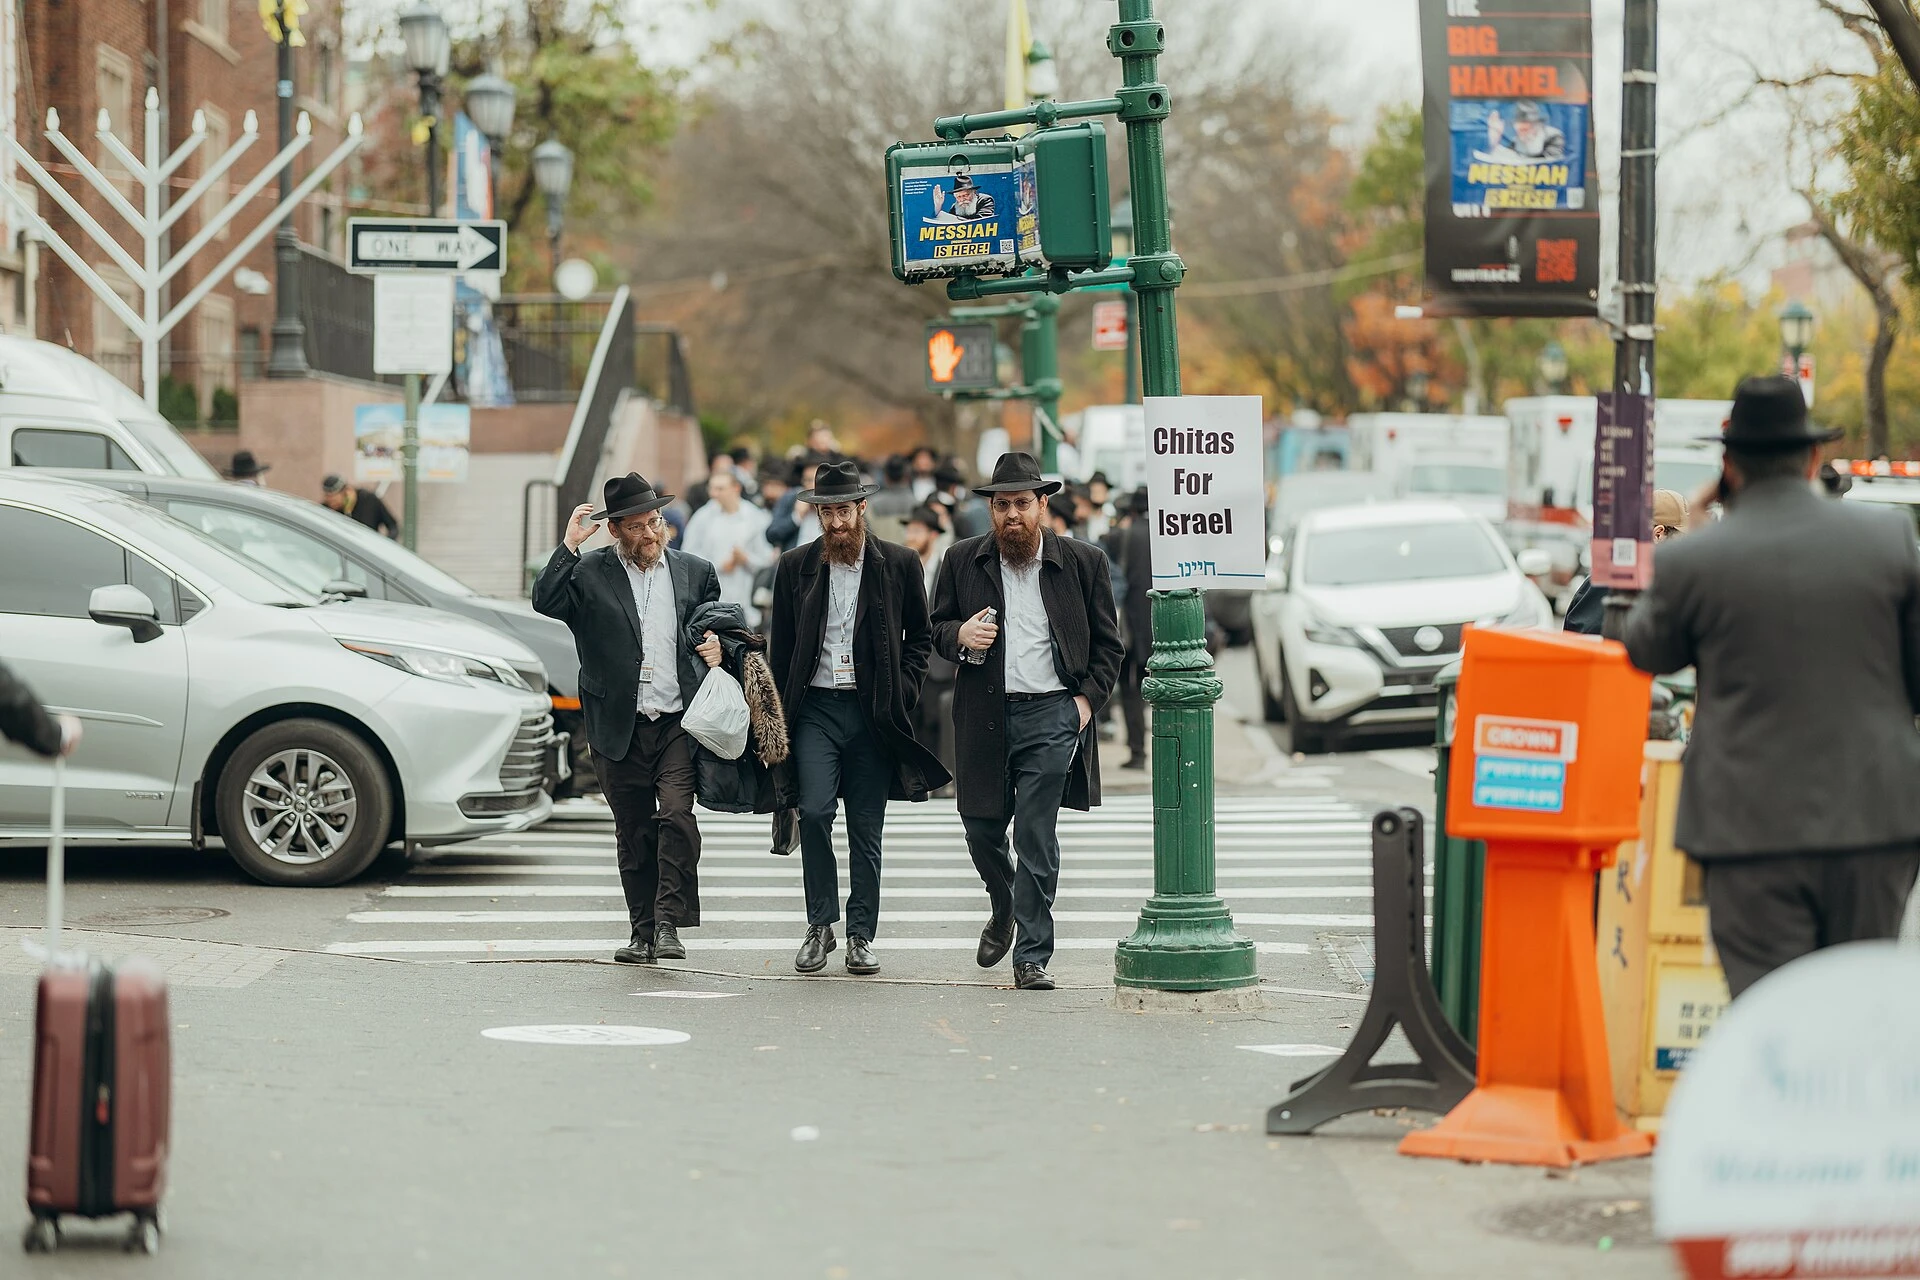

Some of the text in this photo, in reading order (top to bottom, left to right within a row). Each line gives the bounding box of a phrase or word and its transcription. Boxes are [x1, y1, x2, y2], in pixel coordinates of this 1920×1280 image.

[1447, 24, 1498, 56] BIG
[1449, 65, 1565, 97] HAKHEL
[1468, 163, 1568, 186] MESSIAH
[919, 222, 998, 242] MESSIAH
[373, 234, 479, 258] ONE WAY
[936, 243, 989, 257] IS HERE!
[1153, 427, 1235, 455] Chitas
[1173, 468, 1213, 495] For
[1158, 508, 1233, 536] Israel
[1177, 560, 1216, 577] חיינו
